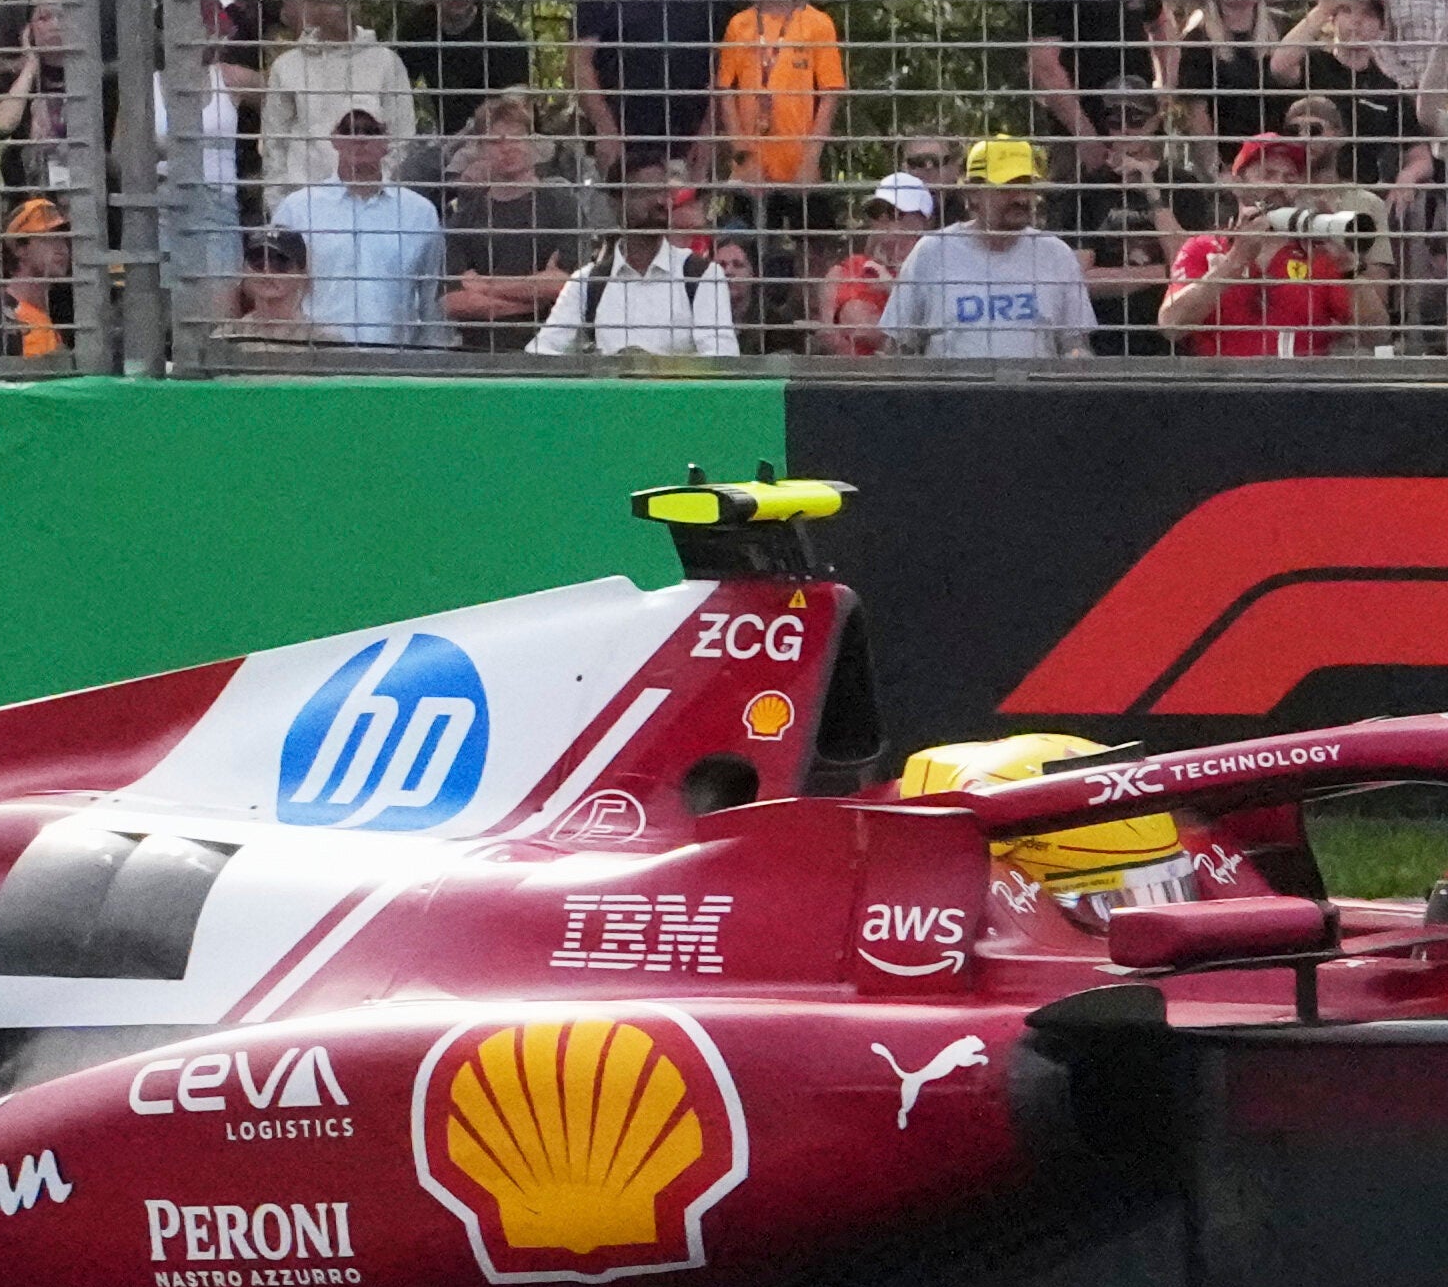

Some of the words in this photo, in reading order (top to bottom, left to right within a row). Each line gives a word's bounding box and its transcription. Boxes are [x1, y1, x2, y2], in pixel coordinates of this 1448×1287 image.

[955, 293, 1039, 323] DR3
[689, 613, 805, 663] ZCG
[290, 633, 476, 828] hp
[1170, 743, 1342, 783] TECHNOLOGY
[550, 894, 734, 974] IBM
[862, 902, 965, 943] aws
[226, 1117, 355, 1142] LOGISTICS
[145, 1199, 356, 1262] PERONI
[250, 1266, 362, 1287] AZZURRO
